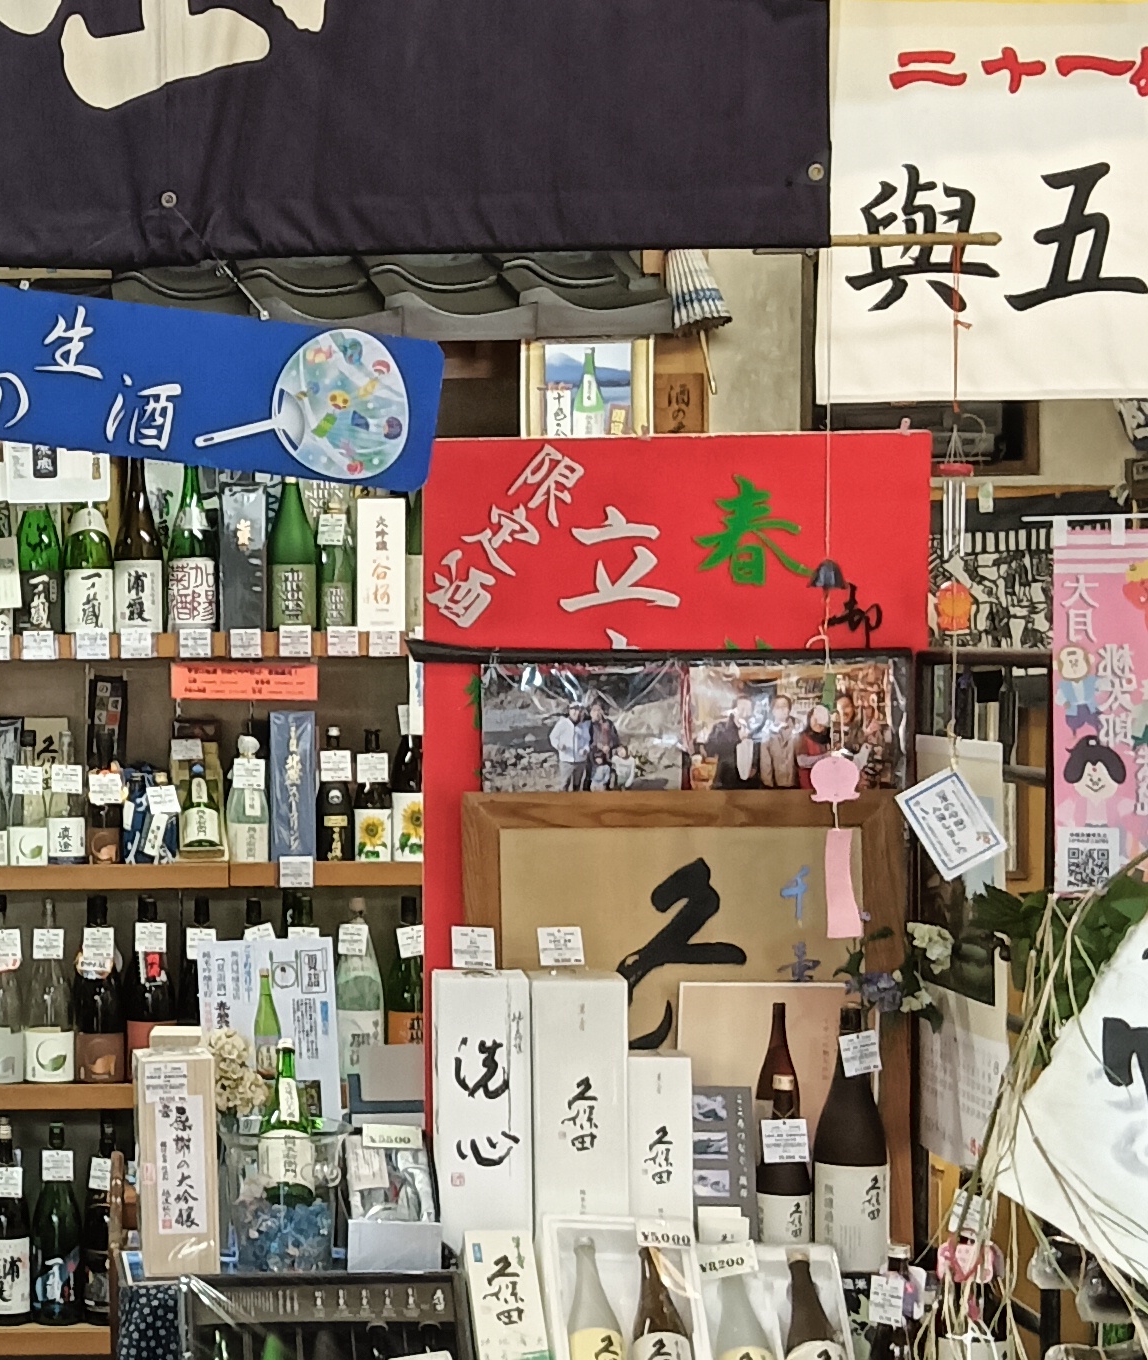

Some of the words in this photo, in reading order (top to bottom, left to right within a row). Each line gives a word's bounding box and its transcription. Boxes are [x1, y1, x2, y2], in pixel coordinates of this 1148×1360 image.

[427, 443, 585, 628] 限定酒
[559, 505, 681, 613] 立
[694, 474, 813, 585] 春
[454, 1036, 521, 1167] 洗心
[561, 1076, 599, 1152] 久保田
[644, 1126, 673, 1185] 久保田
[481, 1254, 526, 1325] 久保田
